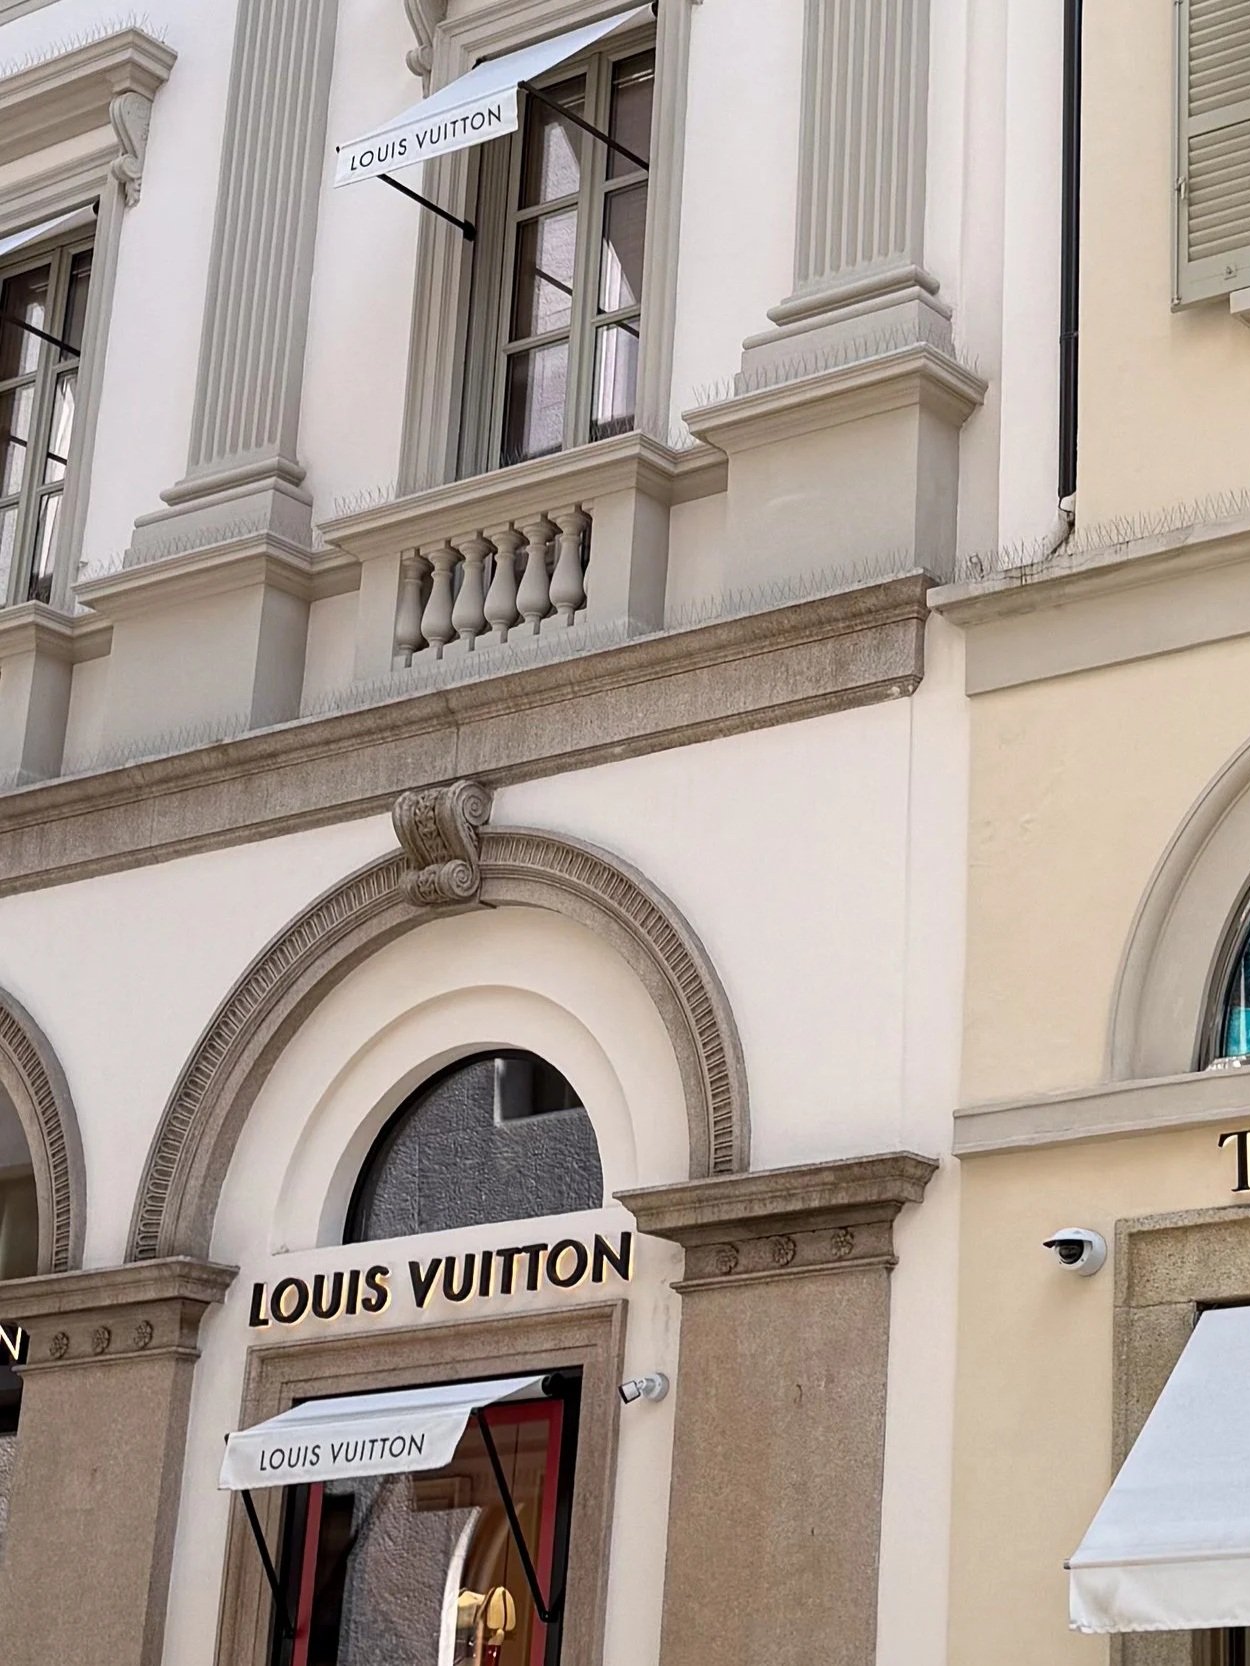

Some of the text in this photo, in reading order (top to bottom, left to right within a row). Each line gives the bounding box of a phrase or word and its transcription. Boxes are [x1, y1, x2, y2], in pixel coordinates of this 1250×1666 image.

[350, 104, 502, 171] LOUIS VUITTON
[248, 1231, 633, 1328] LOUIS VUITTON
[259, 1433, 426, 1472] LOUIS VUITTON
